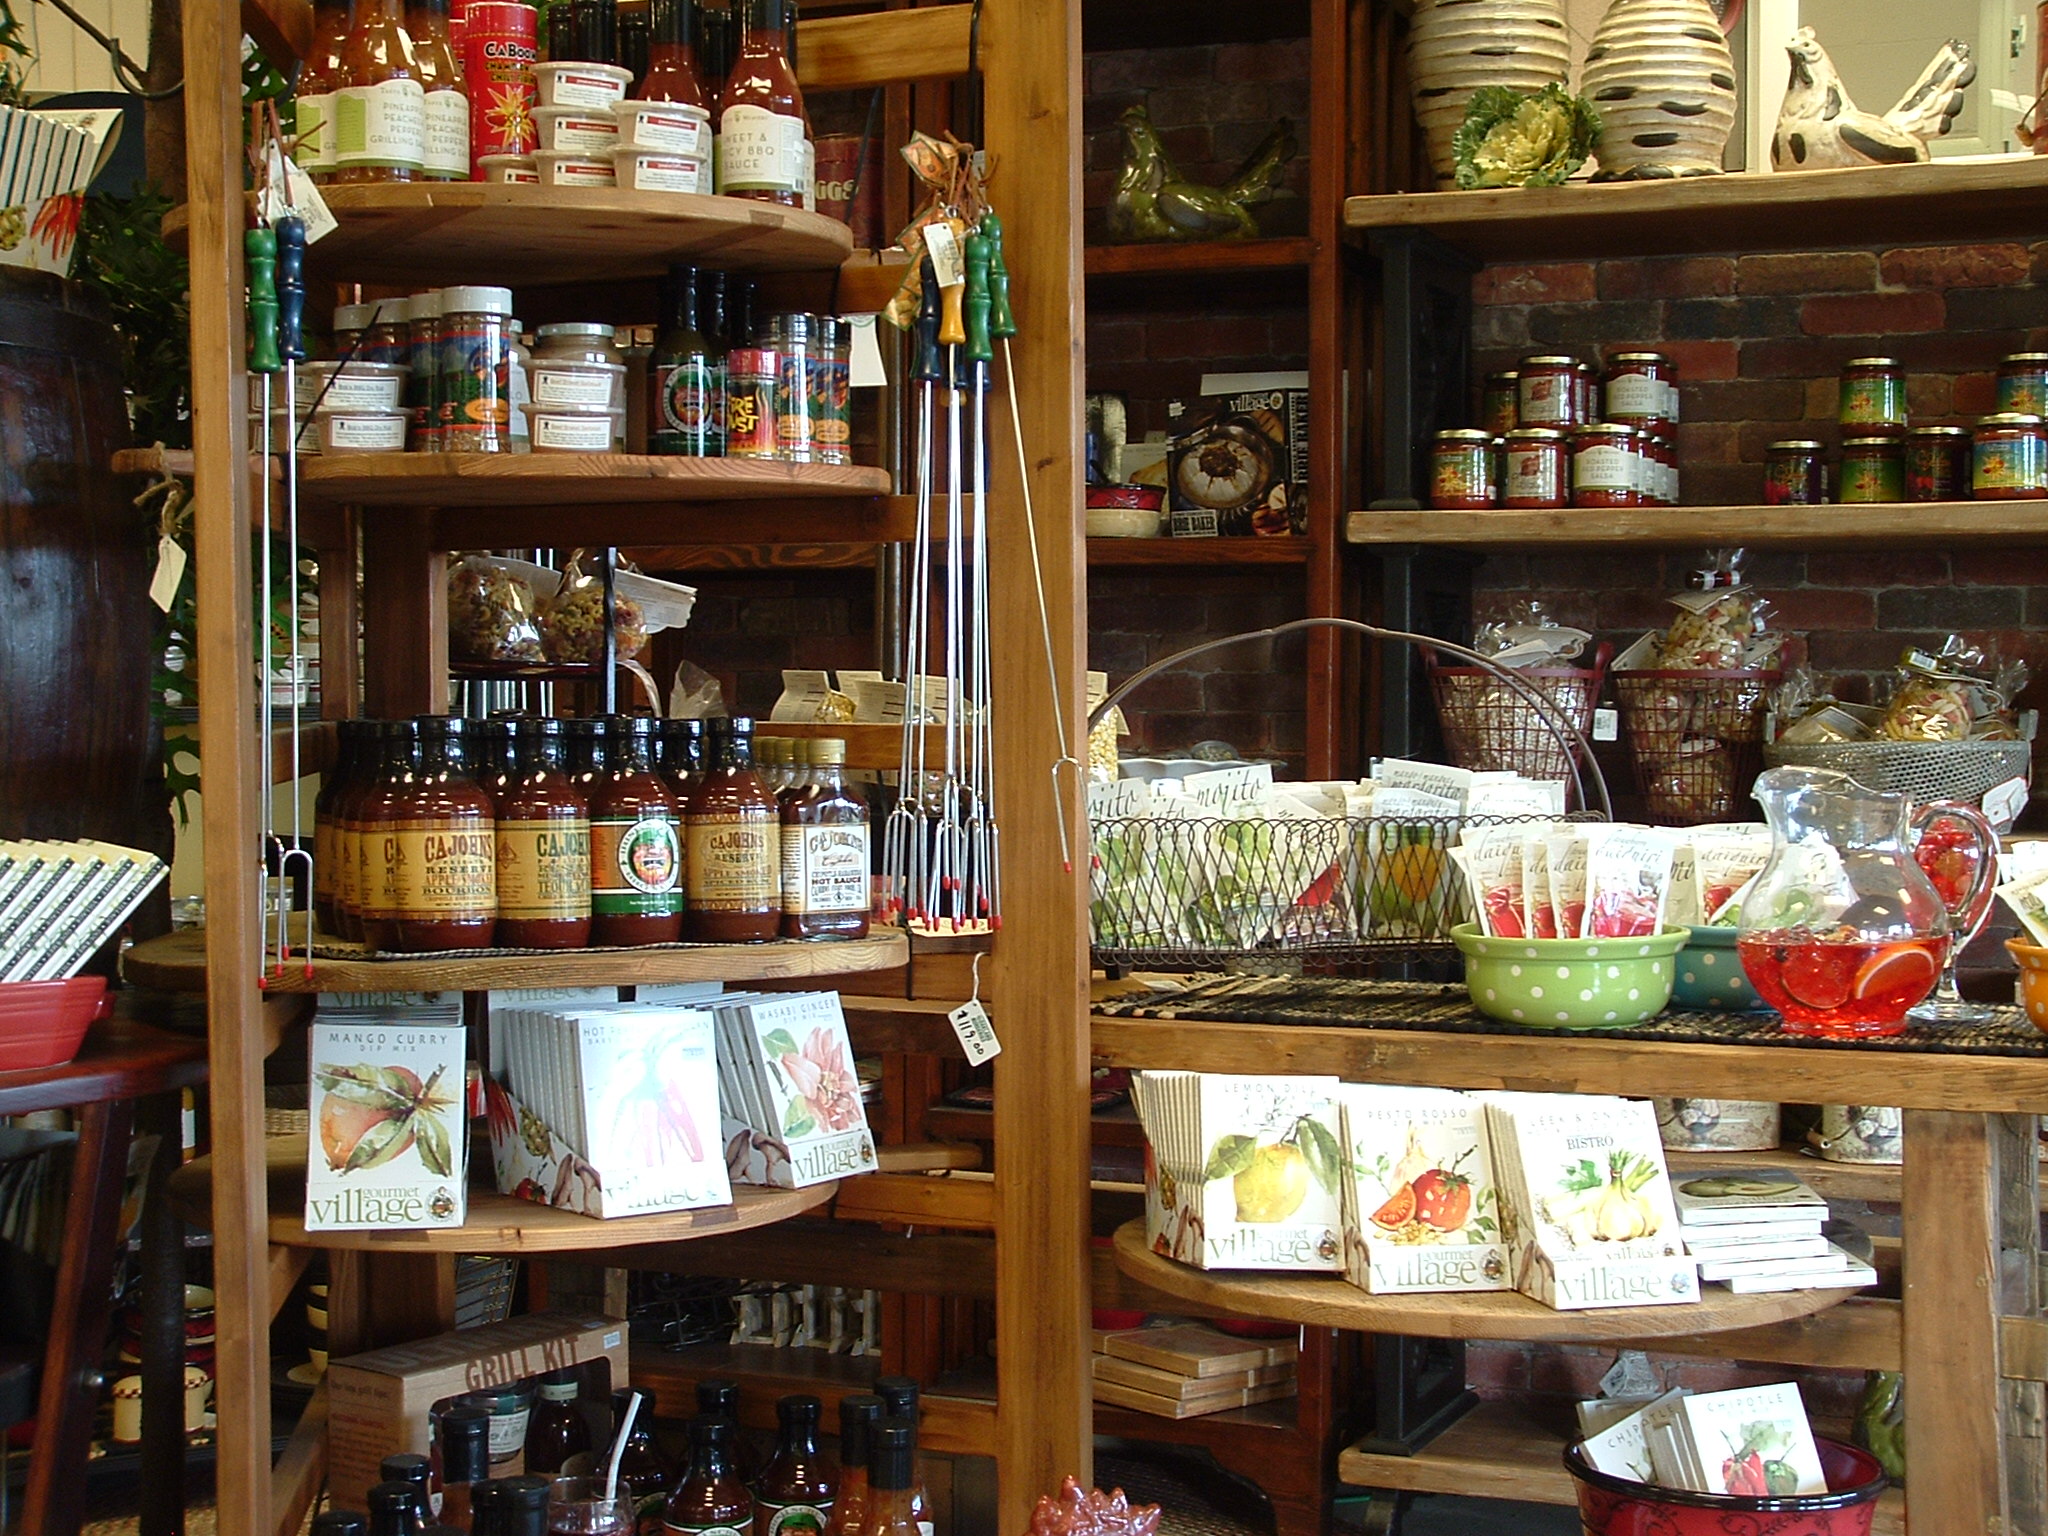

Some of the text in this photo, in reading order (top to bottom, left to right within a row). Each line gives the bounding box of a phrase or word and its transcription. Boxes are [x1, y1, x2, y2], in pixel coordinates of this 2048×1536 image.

[370, 135, 409, 147] GRILLING
[726, 132, 753, 143] WEET
[748, 146, 774, 156] BBQ
[1230, 394, 1270, 411] village
[1197, 770, 1265, 816] mojito
[537, 833, 588, 856] CAJOH
[711, 832, 764, 850] CAJOHNS
[834, 876, 861, 884] SAUCE
[423, 887, 491, 896] BOURBON
[758, 999, 835, 1020] WASABI GINGER
[329, 1033, 448, 1045] MANGO CURRY
[584, 1027, 604, 1036] HOT
[1368, 1109, 1466, 1119] PESTO ROSSO
[1567, 1135, 1614, 1150] BISTRO
[794, 1144, 858, 1180] village
[363, 1187, 419, 1199] gourmet
[311, 1188, 423, 1224] village
[1208, 1228, 1311, 1264] village
[1374, 1253, 1477, 1286] village
[1560, 1267, 1662, 1301] village
[465, 1347, 536, 1391] GRILL
[543, 1336, 578, 1370] KIT
[1708, 1393, 1783, 1412] CHIPOTLE
[1608, 1404, 1674, 1448] CHIPOTLE
